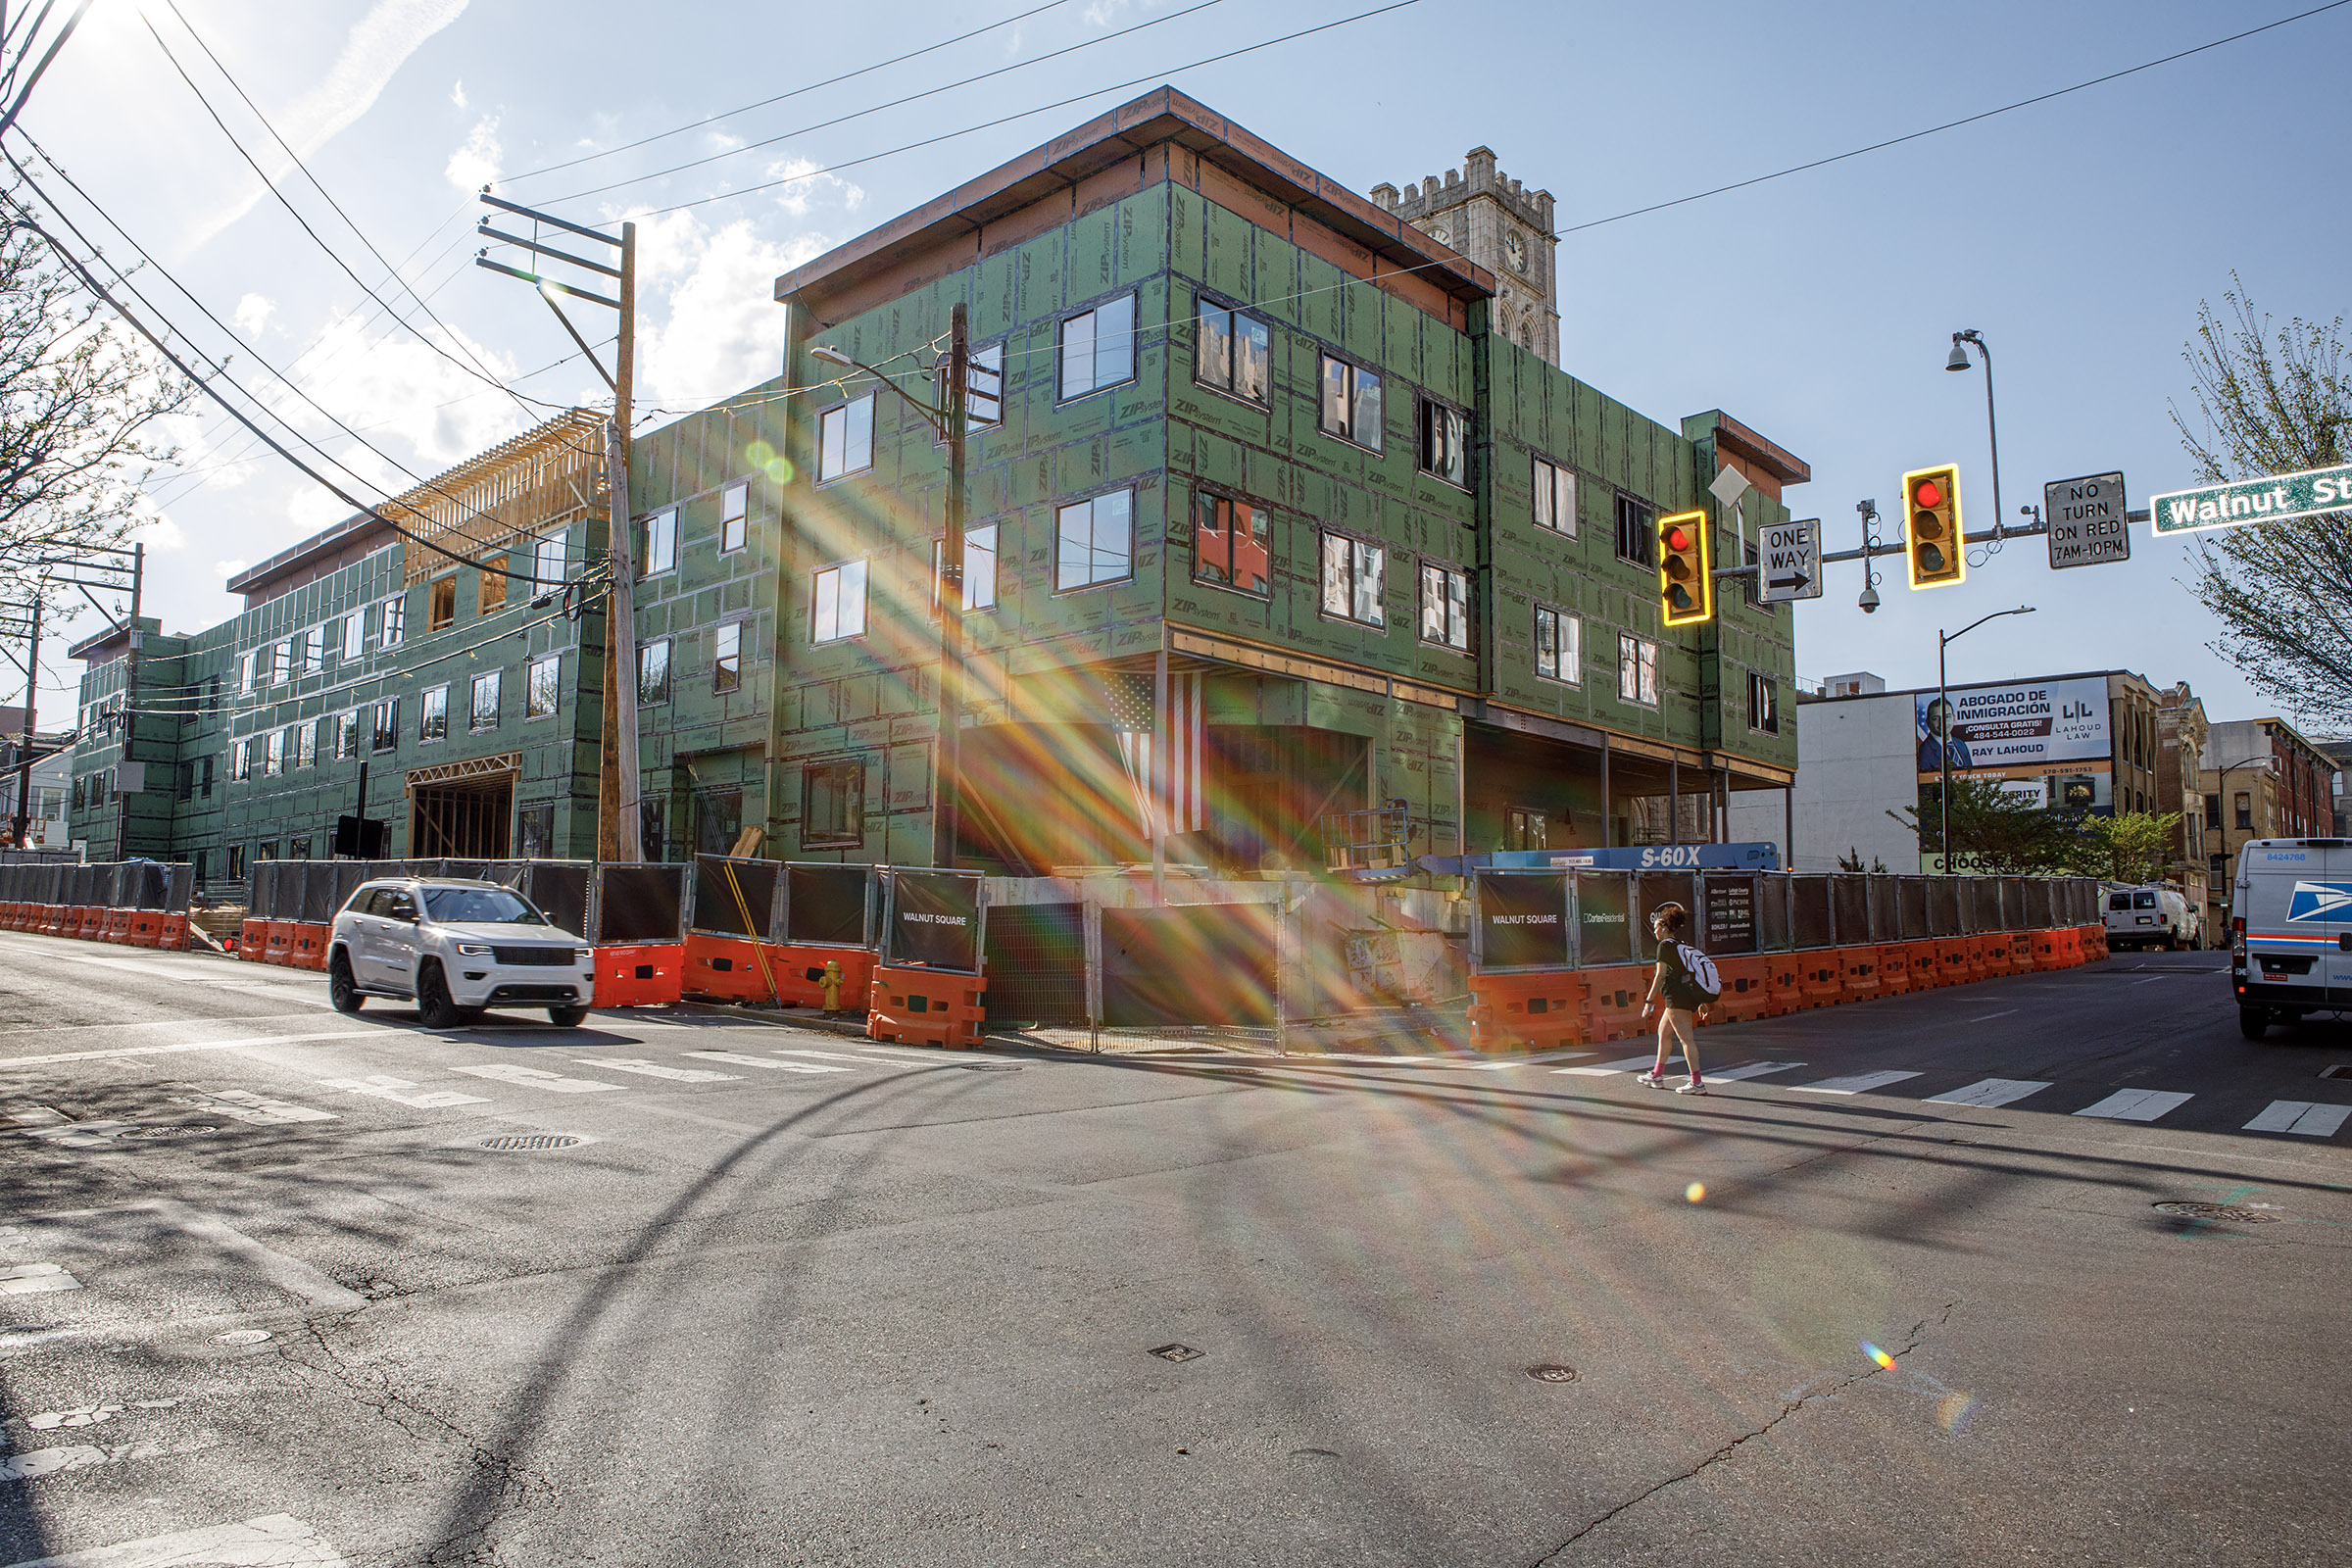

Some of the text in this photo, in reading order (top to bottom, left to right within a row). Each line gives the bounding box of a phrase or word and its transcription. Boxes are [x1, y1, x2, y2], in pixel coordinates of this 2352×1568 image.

[2071, 484, 2099, 501] NO
[2170, 476, 2352, 524] Walnut St
[2062, 502, 2109, 520] TURN
[1770, 528, 1808, 548] ONE
[2055, 520, 2120, 541] ON RED
[2054, 539, 2123, 560] 7AM-10PM
[1770, 549, 1809, 569] WAY
[1959, 690, 2047, 708] ABOGADO DE
[1956, 701, 2051, 720] INMIGRACIÓN
[2010, 719, 2043, 729] GRATIS!
[2055, 723, 2101, 733] LAHOUD
[1973, 728, 2035, 740] 484-544-0022
[1972, 744, 2044, 758] RAY LAHOUD
[903, 911, 966, 926] WALNUT SQUARE
[1493, 913, 1557, 925] WALNUT SQUARE
